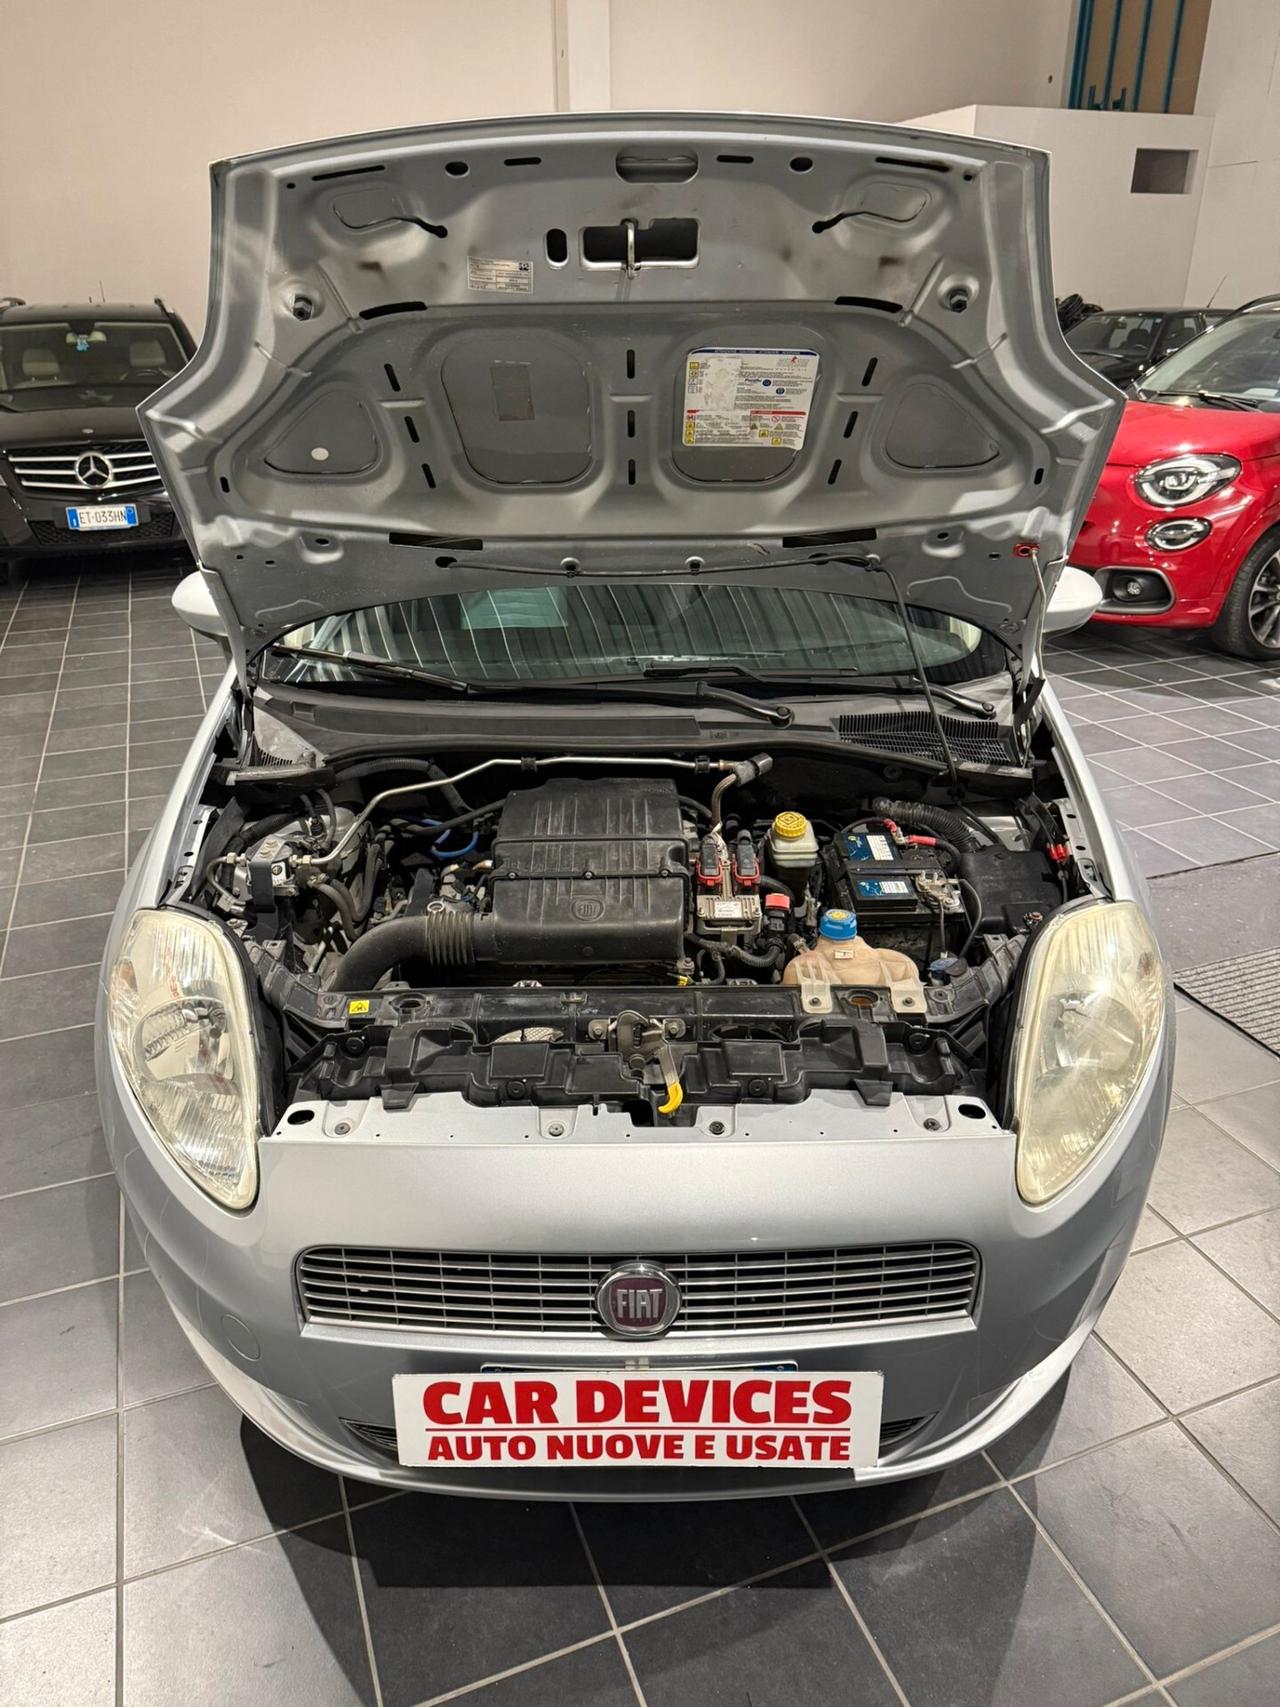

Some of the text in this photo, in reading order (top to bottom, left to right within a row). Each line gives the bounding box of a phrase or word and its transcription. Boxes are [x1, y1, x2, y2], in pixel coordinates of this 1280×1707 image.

[617, 1288, 663, 1319] FIAT
[423, 1379, 852, 1425] CAR DEVICES
[428, 1434, 849, 1461] AUTO NUOVE E USATE
